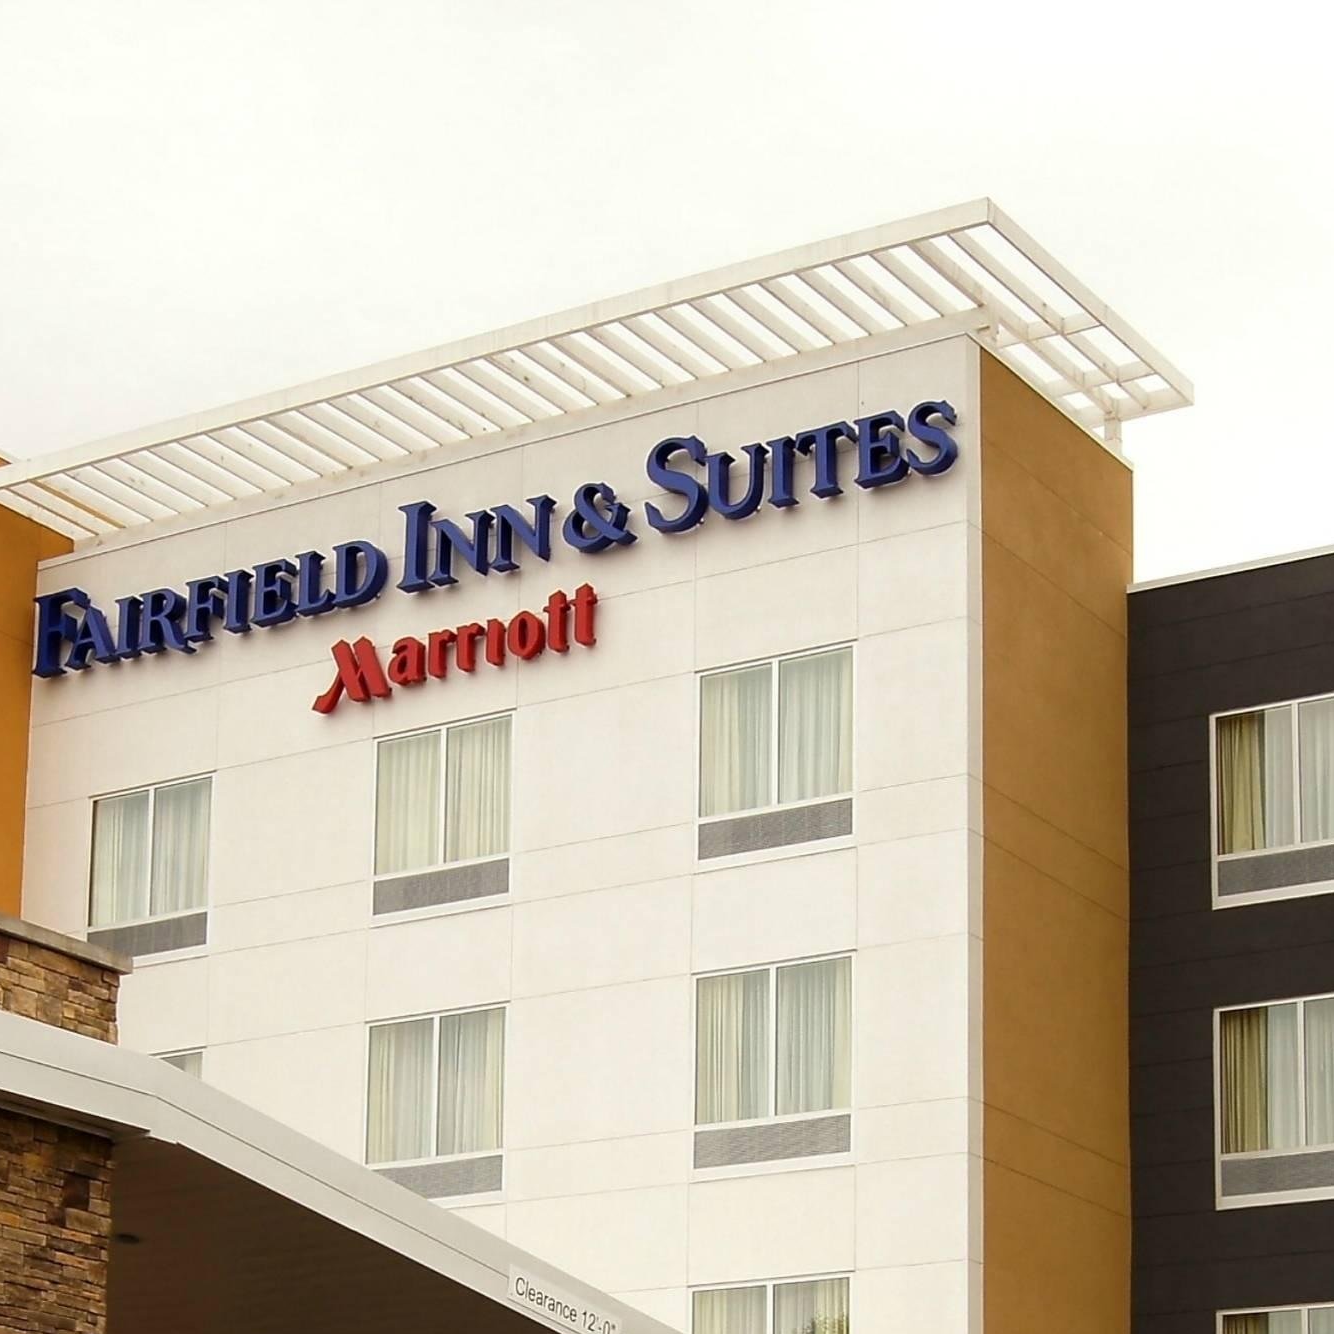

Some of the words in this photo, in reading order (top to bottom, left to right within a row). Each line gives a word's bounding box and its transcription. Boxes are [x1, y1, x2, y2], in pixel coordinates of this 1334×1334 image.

[31, 540, 388, 678] FAIRFIELD
[396, 495, 555, 593] INN
[563, 482, 637, 554] &
[645, 400, 958, 533] SUITES
[311, 583, 598, 715] Marriott
[516, 1277, 577, 1322] Clearance
